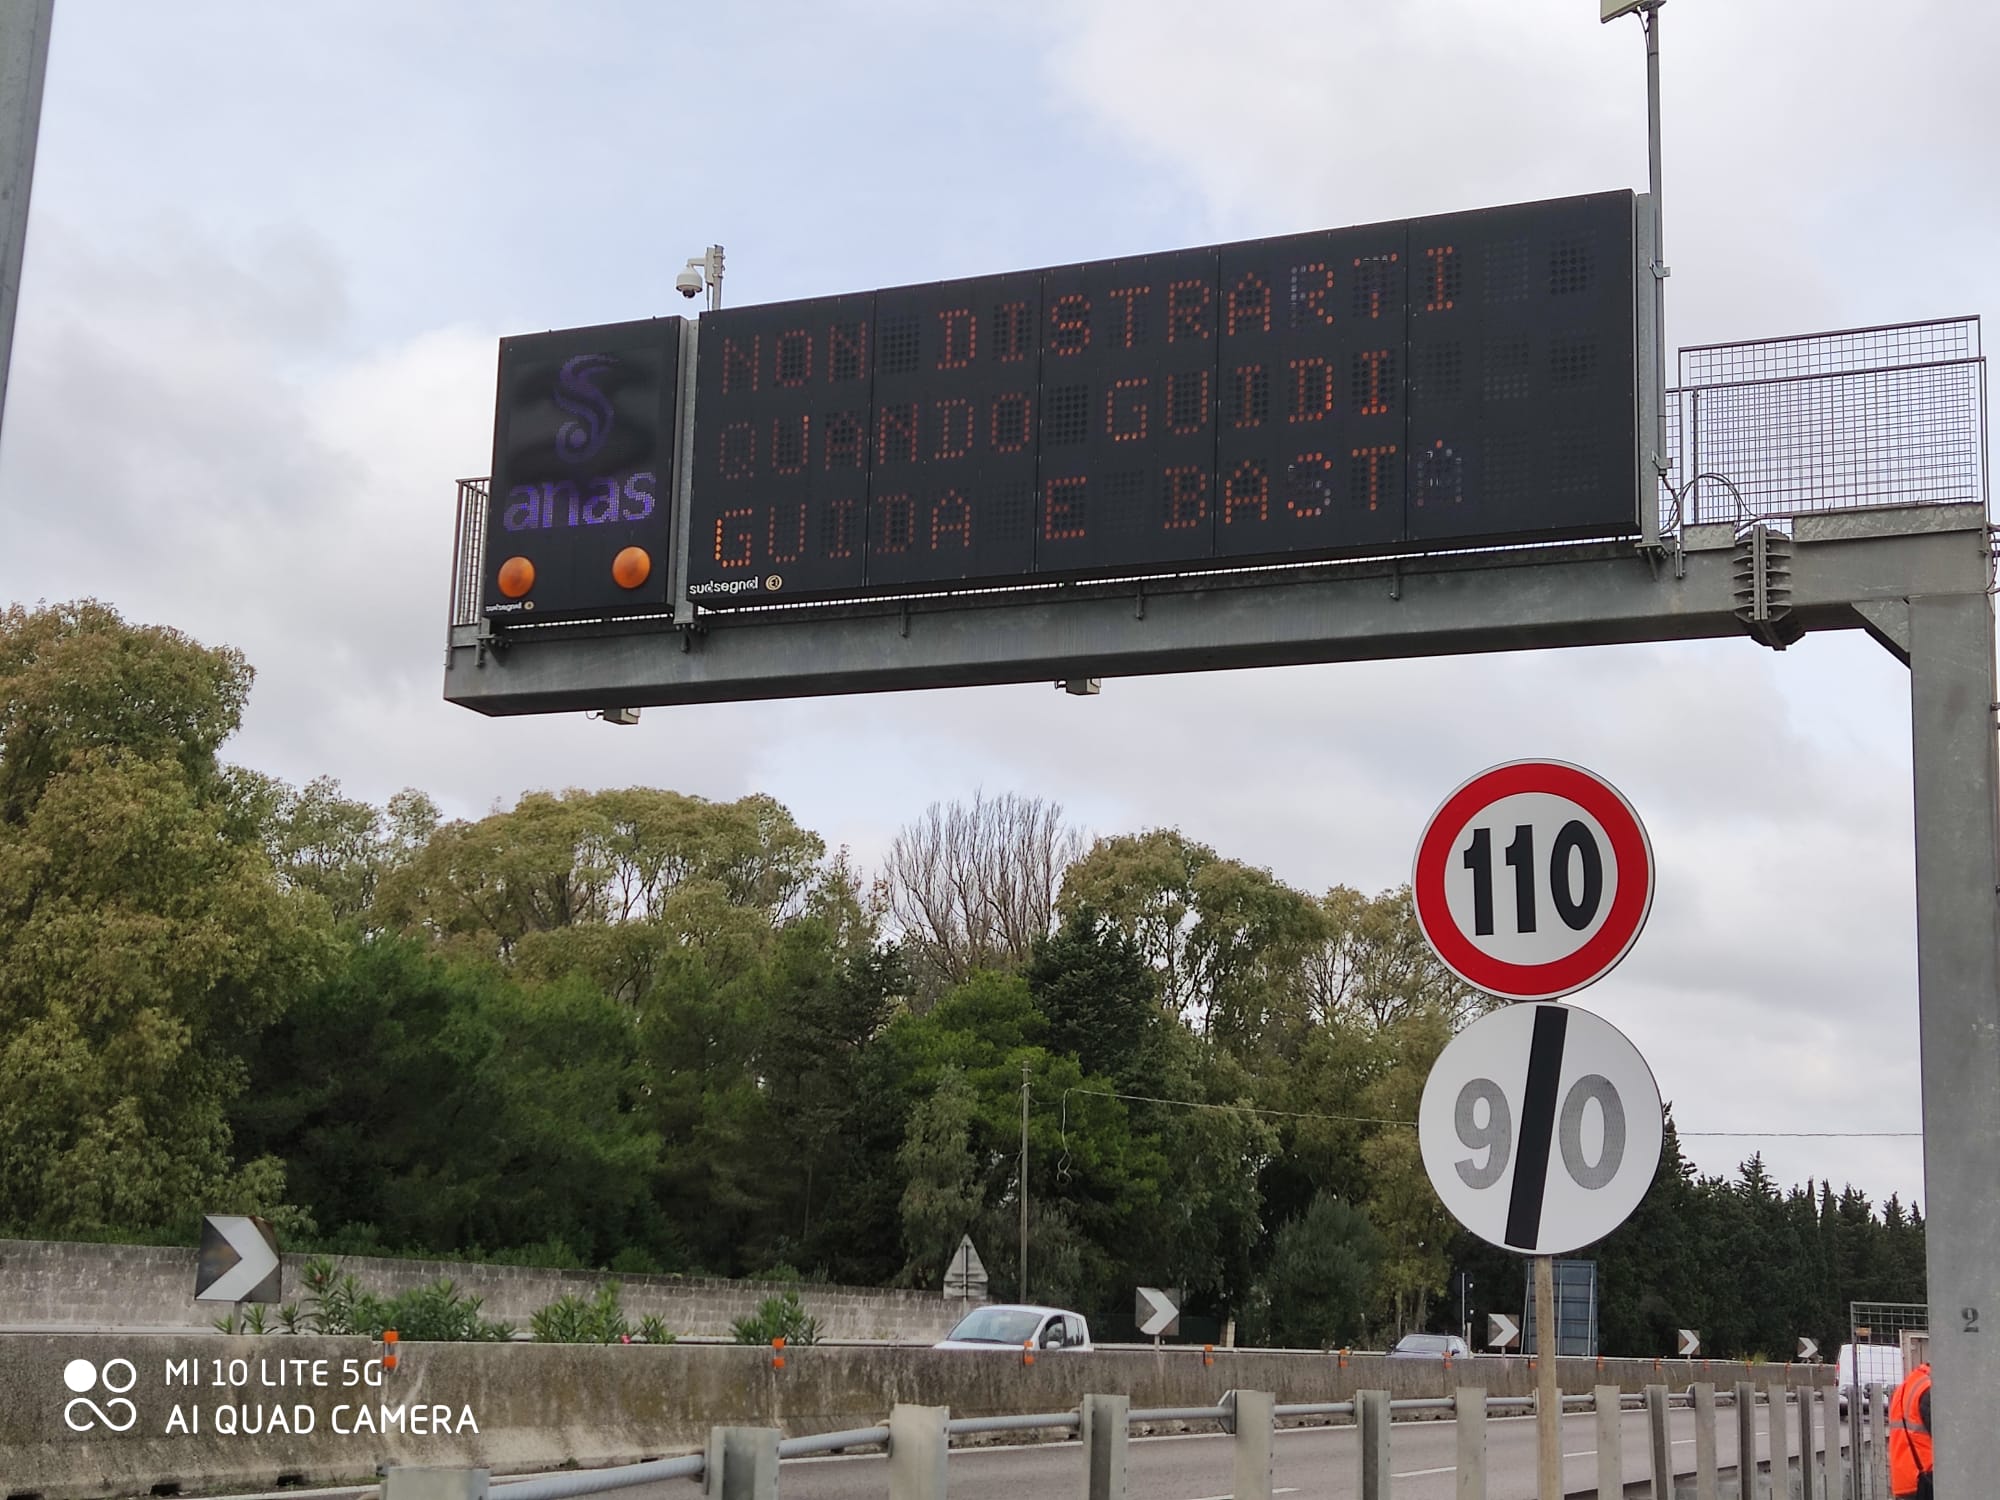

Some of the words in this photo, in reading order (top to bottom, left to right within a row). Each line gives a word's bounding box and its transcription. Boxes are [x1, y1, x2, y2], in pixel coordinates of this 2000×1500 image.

[721, 320, 867, 395] NON
[935, 244, 1455, 371] DISTRARTI
[718, 391, 1032, 481] QUANDO
[1105, 348, 1389, 442] GUIDI
[503, 471, 657, 532] anas
[713, 488, 971, 569] GUIDA
[1044, 475, 1088, 540] E
[1162, 438, 1464, 530] BASTA
[1463, 819, 1603, 936] 110
[1454, 1073, 1627, 1190] 90
